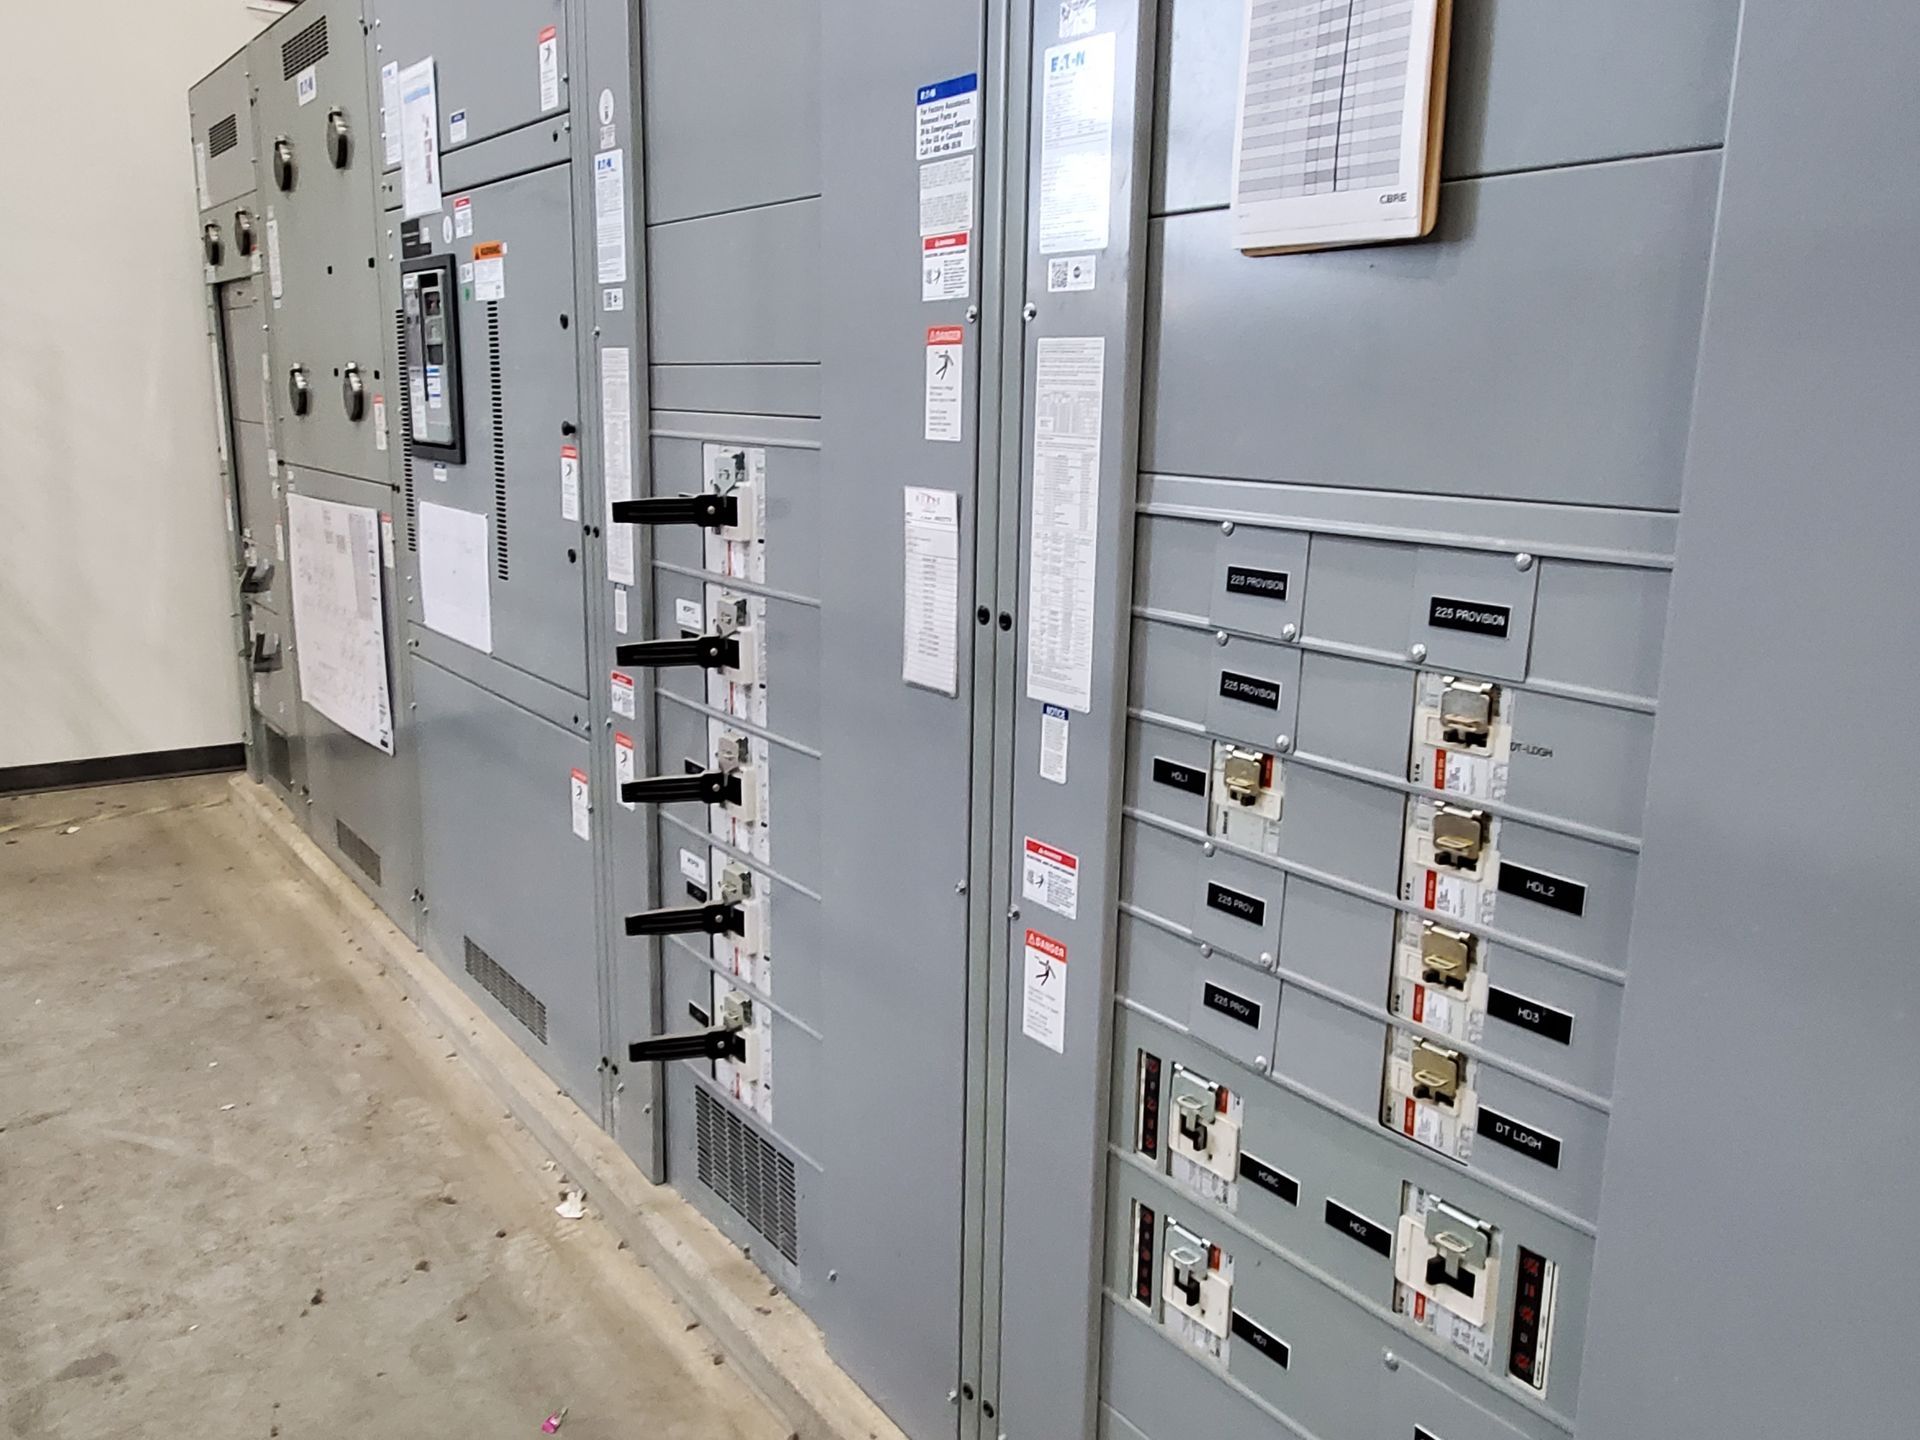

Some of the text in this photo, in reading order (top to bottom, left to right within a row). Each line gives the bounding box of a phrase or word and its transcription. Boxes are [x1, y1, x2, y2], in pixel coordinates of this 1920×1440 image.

[1379, 191, 1408, 205] CBRE
[1230, 574, 1246, 586] 225
[1434, 606, 1506, 627] 225 PROVISION
[1223, 679, 1239, 691] 225
[1525, 879, 1556, 897] HDL2
[1217, 893, 1255, 914] 225 PROV
[1035, 936, 1065, 958] DANGER
[1517, 1007, 1541, 1024] HD3
[1495, 1121, 1543, 1151] DT LDGH
[1349, 1220, 1368, 1238] HD2
